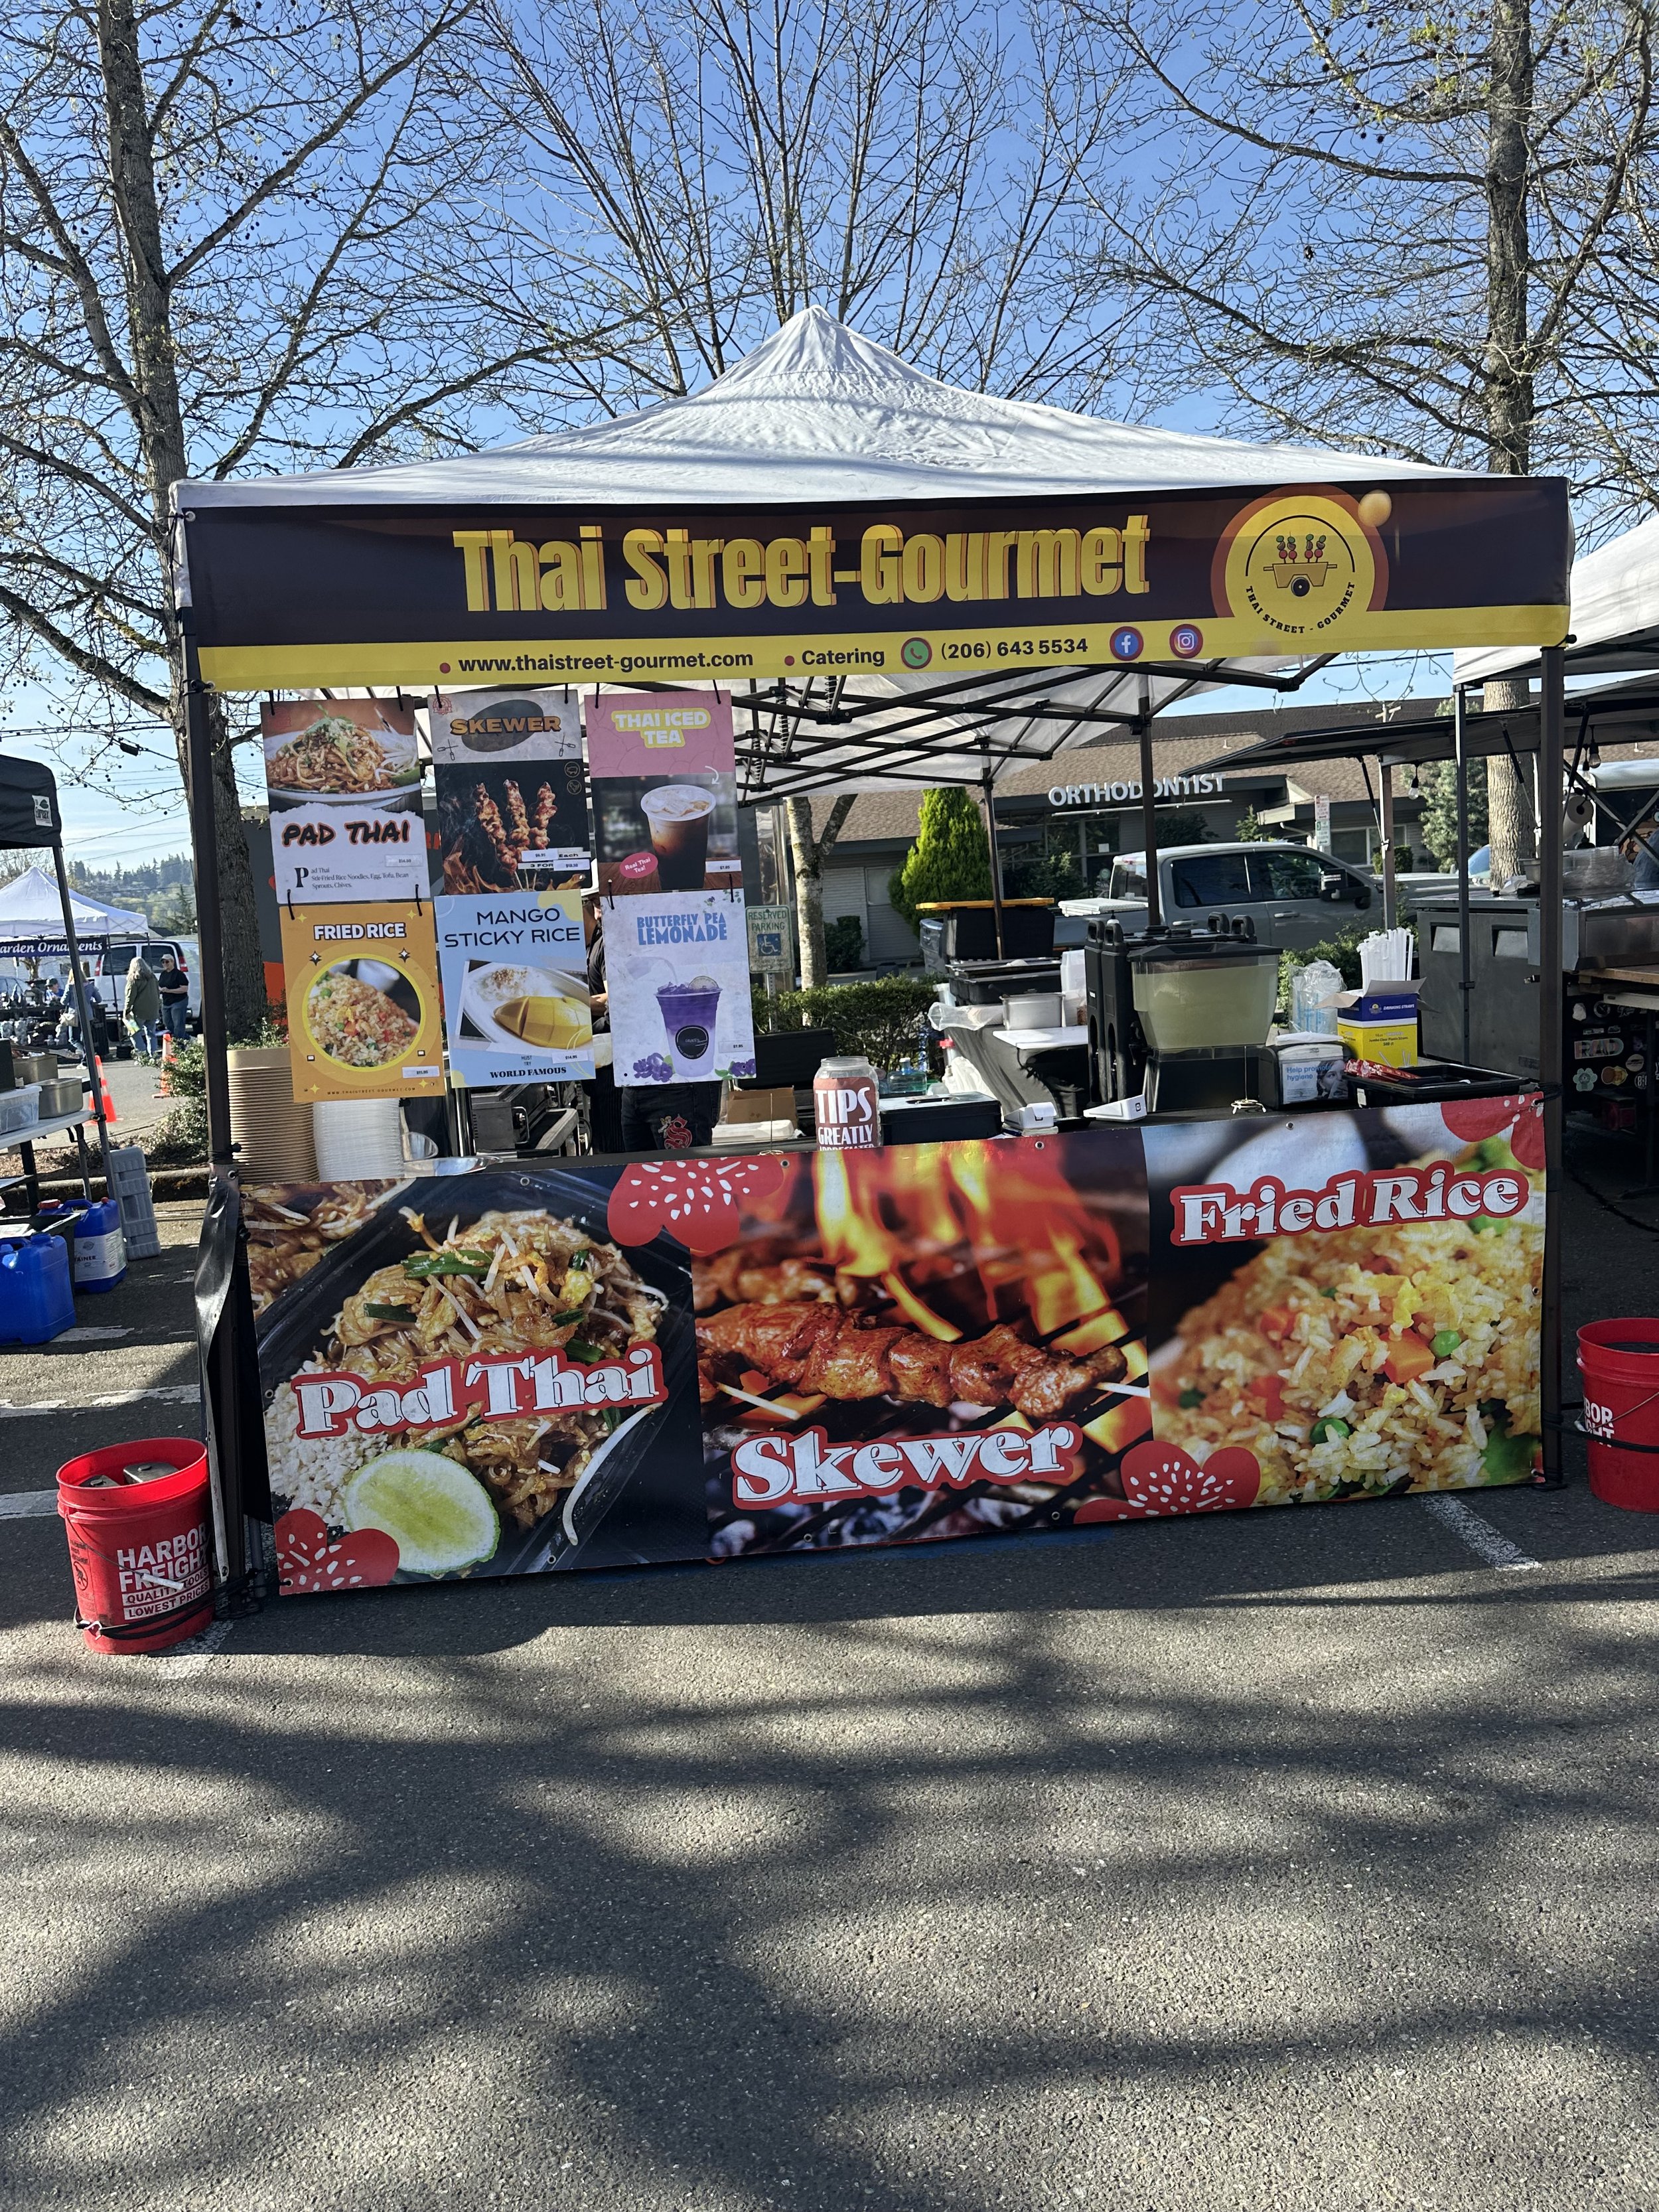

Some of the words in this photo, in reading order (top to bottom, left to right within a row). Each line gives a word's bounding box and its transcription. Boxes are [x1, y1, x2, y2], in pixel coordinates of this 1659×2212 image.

[453, 526, 607, 611] Thai
[622, 515, 1150, 610] Street-Gourmet
[1246, 585, 1263, 615] THAI
[1262, 614, 1305, 633] STREET
[1317, 581, 1355, 629] GOURMET
[458, 652, 754, 672] www.thaistreet-gourmet.com
[802, 648, 885, 666] Catering
[940, 640, 992, 660] (206)
[997, 640, 1035, 656] 643
[1039, 638, 1088, 654] 5534
[450, 715, 561, 735] SKEWER
[615, 713, 660, 728] THAI
[665, 711, 708, 727] ICED
[644, 730, 682, 745] TEA
[1048, 773, 1226, 806] ORTHODONTIST
[282, 822, 336, 848] PAD
[344, 819, 411, 846] THAI
[624, 862, 638, 871] Real
[638, 857, 651, 865] Thai
[476, 908, 560, 925] MANGO
[636, 913, 699, 928] BUTTERFLY
[704, 912, 727, 924] PEA
[748, 911, 787, 921] RESERVED
[751, 921, 785, 932] PARKING
[314, 924, 364, 940] FRIED
[366, 922, 406, 938] RICE
[445, 930, 524, 948] STICKY
[532, 927, 581, 944] RICE
[637, 923, 727, 945] LEMONADE
[38, 941, 103, 952] Ornaents
[490, 1070, 526, 1078] WORLD
[528, 1067, 567, 1076] FAMOUS
[1287, 1073, 1313, 1082] hygiene
[815, 1086, 872, 1124] TIPS
[818, 1124, 873, 1145] GREATLY
[1180, 1179, 1356, 1242] Fried
[1368, 1168, 1520, 1223] Rice
[295, 1364, 459, 1436] Pad
[465, 1348, 660, 1419] Thai
[1583, 1396, 1614, 1428] BOR
[737, 1426, 1074, 1502] Skewer
[117, 1522, 208, 1570] HARBOR
[129, 1598, 177, 1618] LOWEST
[179, 1582, 209, 1605] PRICES
